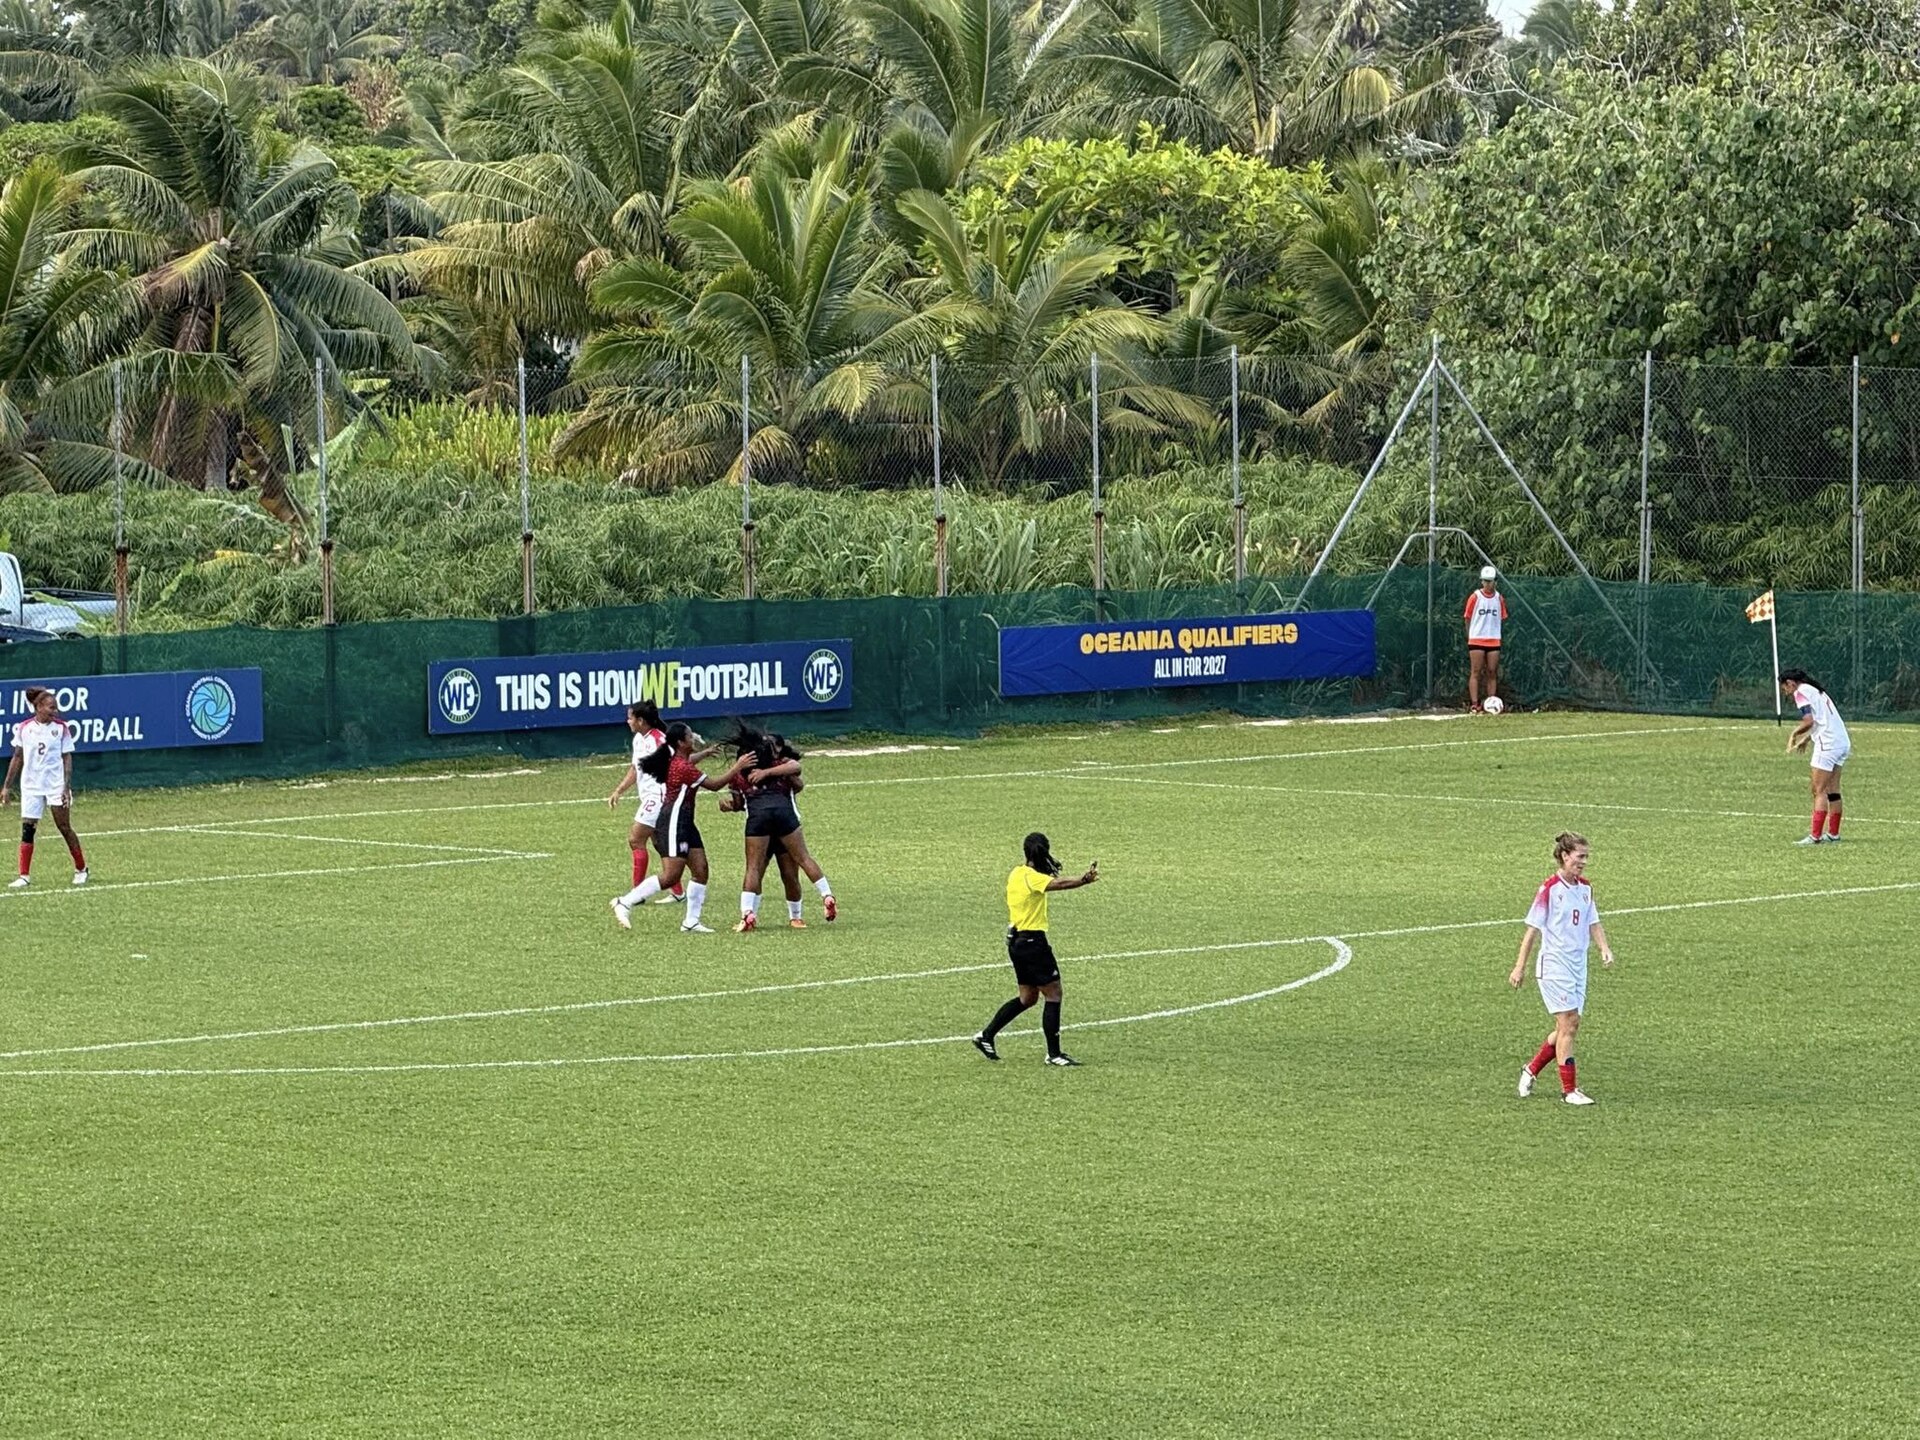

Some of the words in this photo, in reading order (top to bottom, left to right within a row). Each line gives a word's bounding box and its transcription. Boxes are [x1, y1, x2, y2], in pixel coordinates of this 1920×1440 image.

[1478, 608, 1498, 617] OFC
[1080, 629, 1175, 655] OCEANIA
[1178, 623, 1299, 654] QUALIFIERS
[1154, 658, 1171, 679] ALL
[1172, 658, 1183, 678] IN
[1183, 657, 1203, 677] FOR
[1203, 655, 1227, 676] 2027
[496, 673, 551, 712] THIS
[559, 672, 582, 709] IS
[38, 742, 46, 756] 2
[1573, 909, 1580, 926] 8
